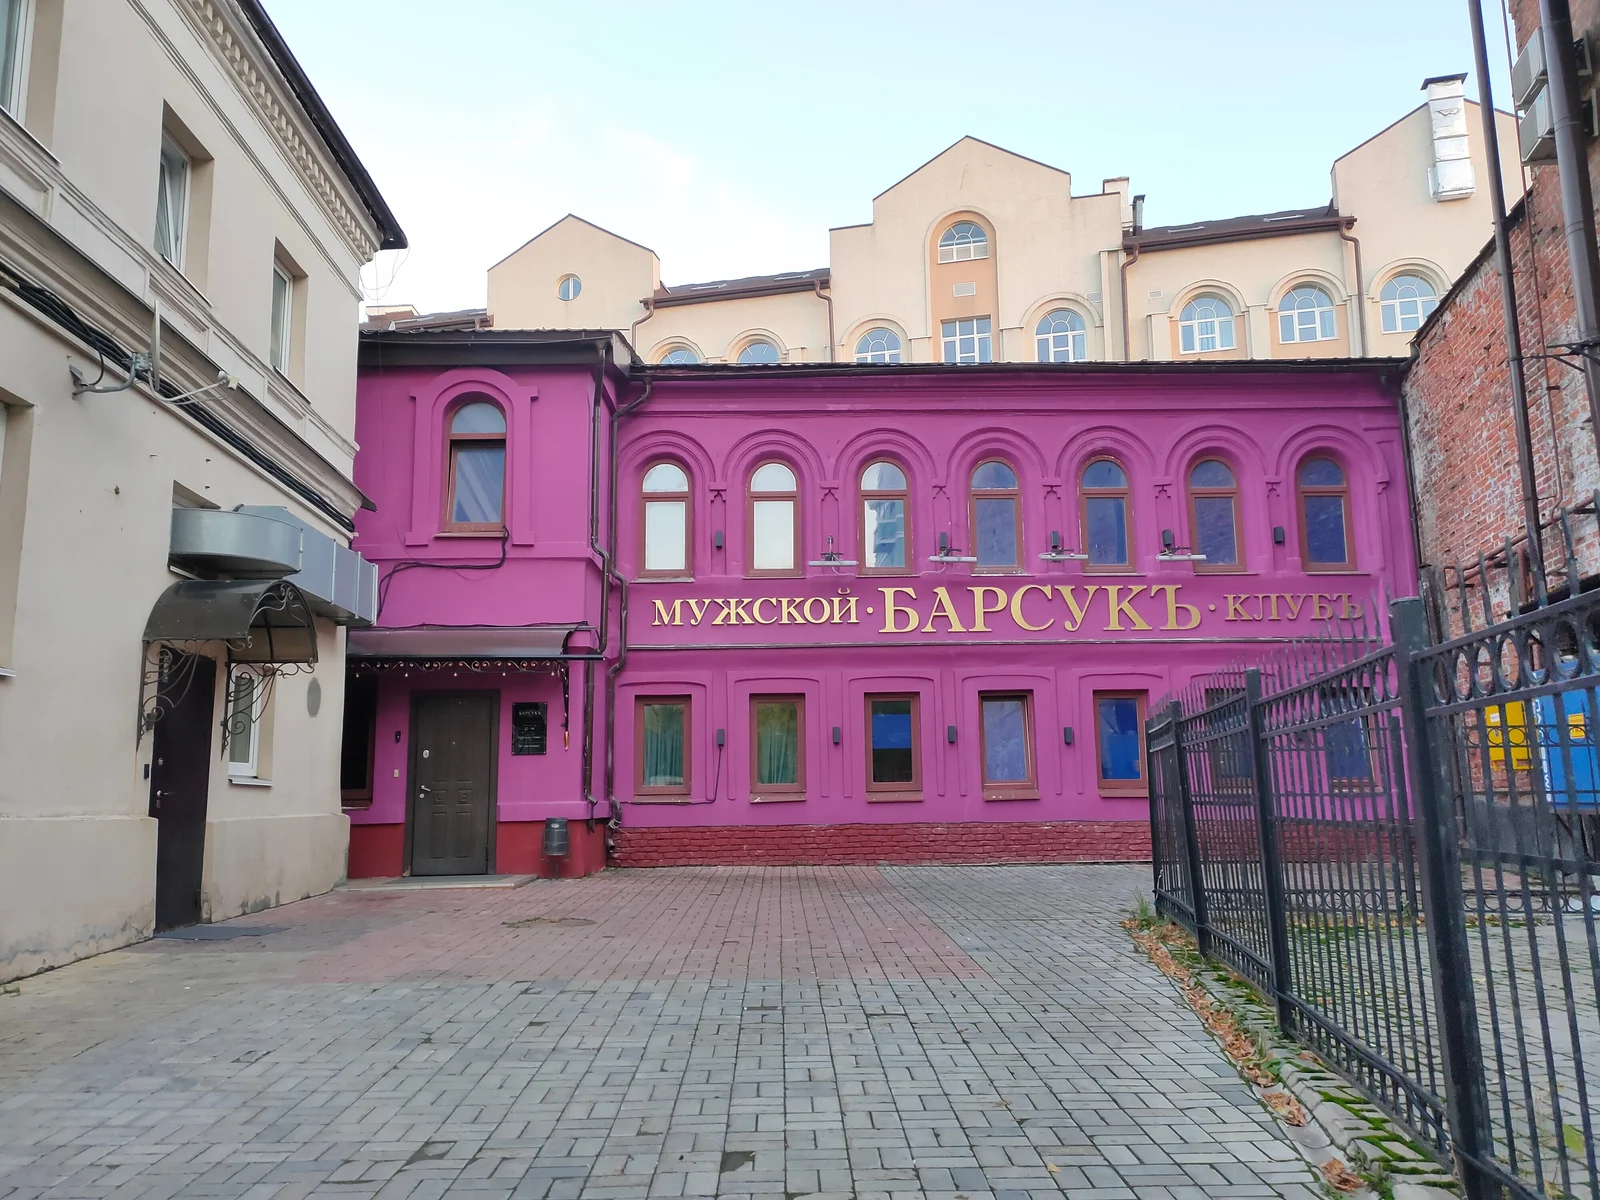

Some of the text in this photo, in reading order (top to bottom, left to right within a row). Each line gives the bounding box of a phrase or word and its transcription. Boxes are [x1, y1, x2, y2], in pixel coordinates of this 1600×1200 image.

[652, 584, 1363, 633] МУЖСКОЙ БАРСУКЪ КЛУБЪ
